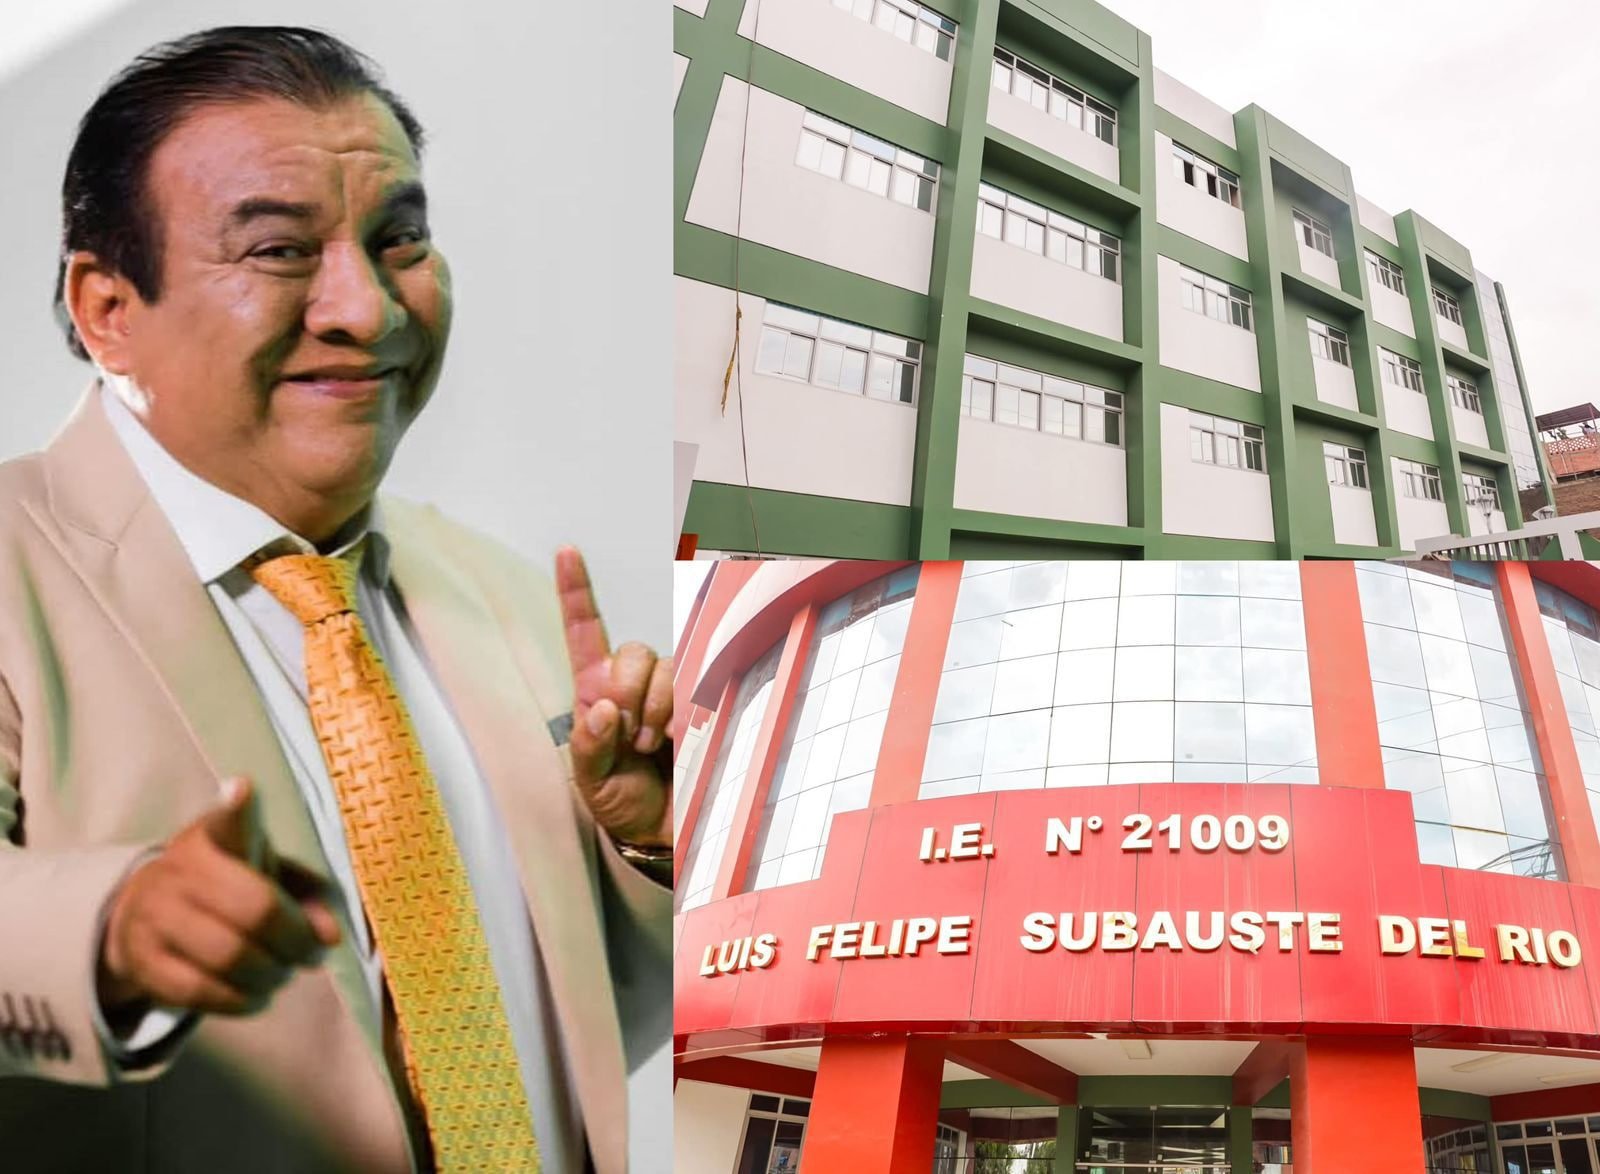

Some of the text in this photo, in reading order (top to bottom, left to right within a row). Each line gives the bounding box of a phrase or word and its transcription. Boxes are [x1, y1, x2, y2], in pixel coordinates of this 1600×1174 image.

[919, 822, 995, 862] I.E.
[1121, 813, 1290, 852] 21009
[699, 911, 1582, 977] LUIS FELIPE SUBAUSTE DEL RIO
